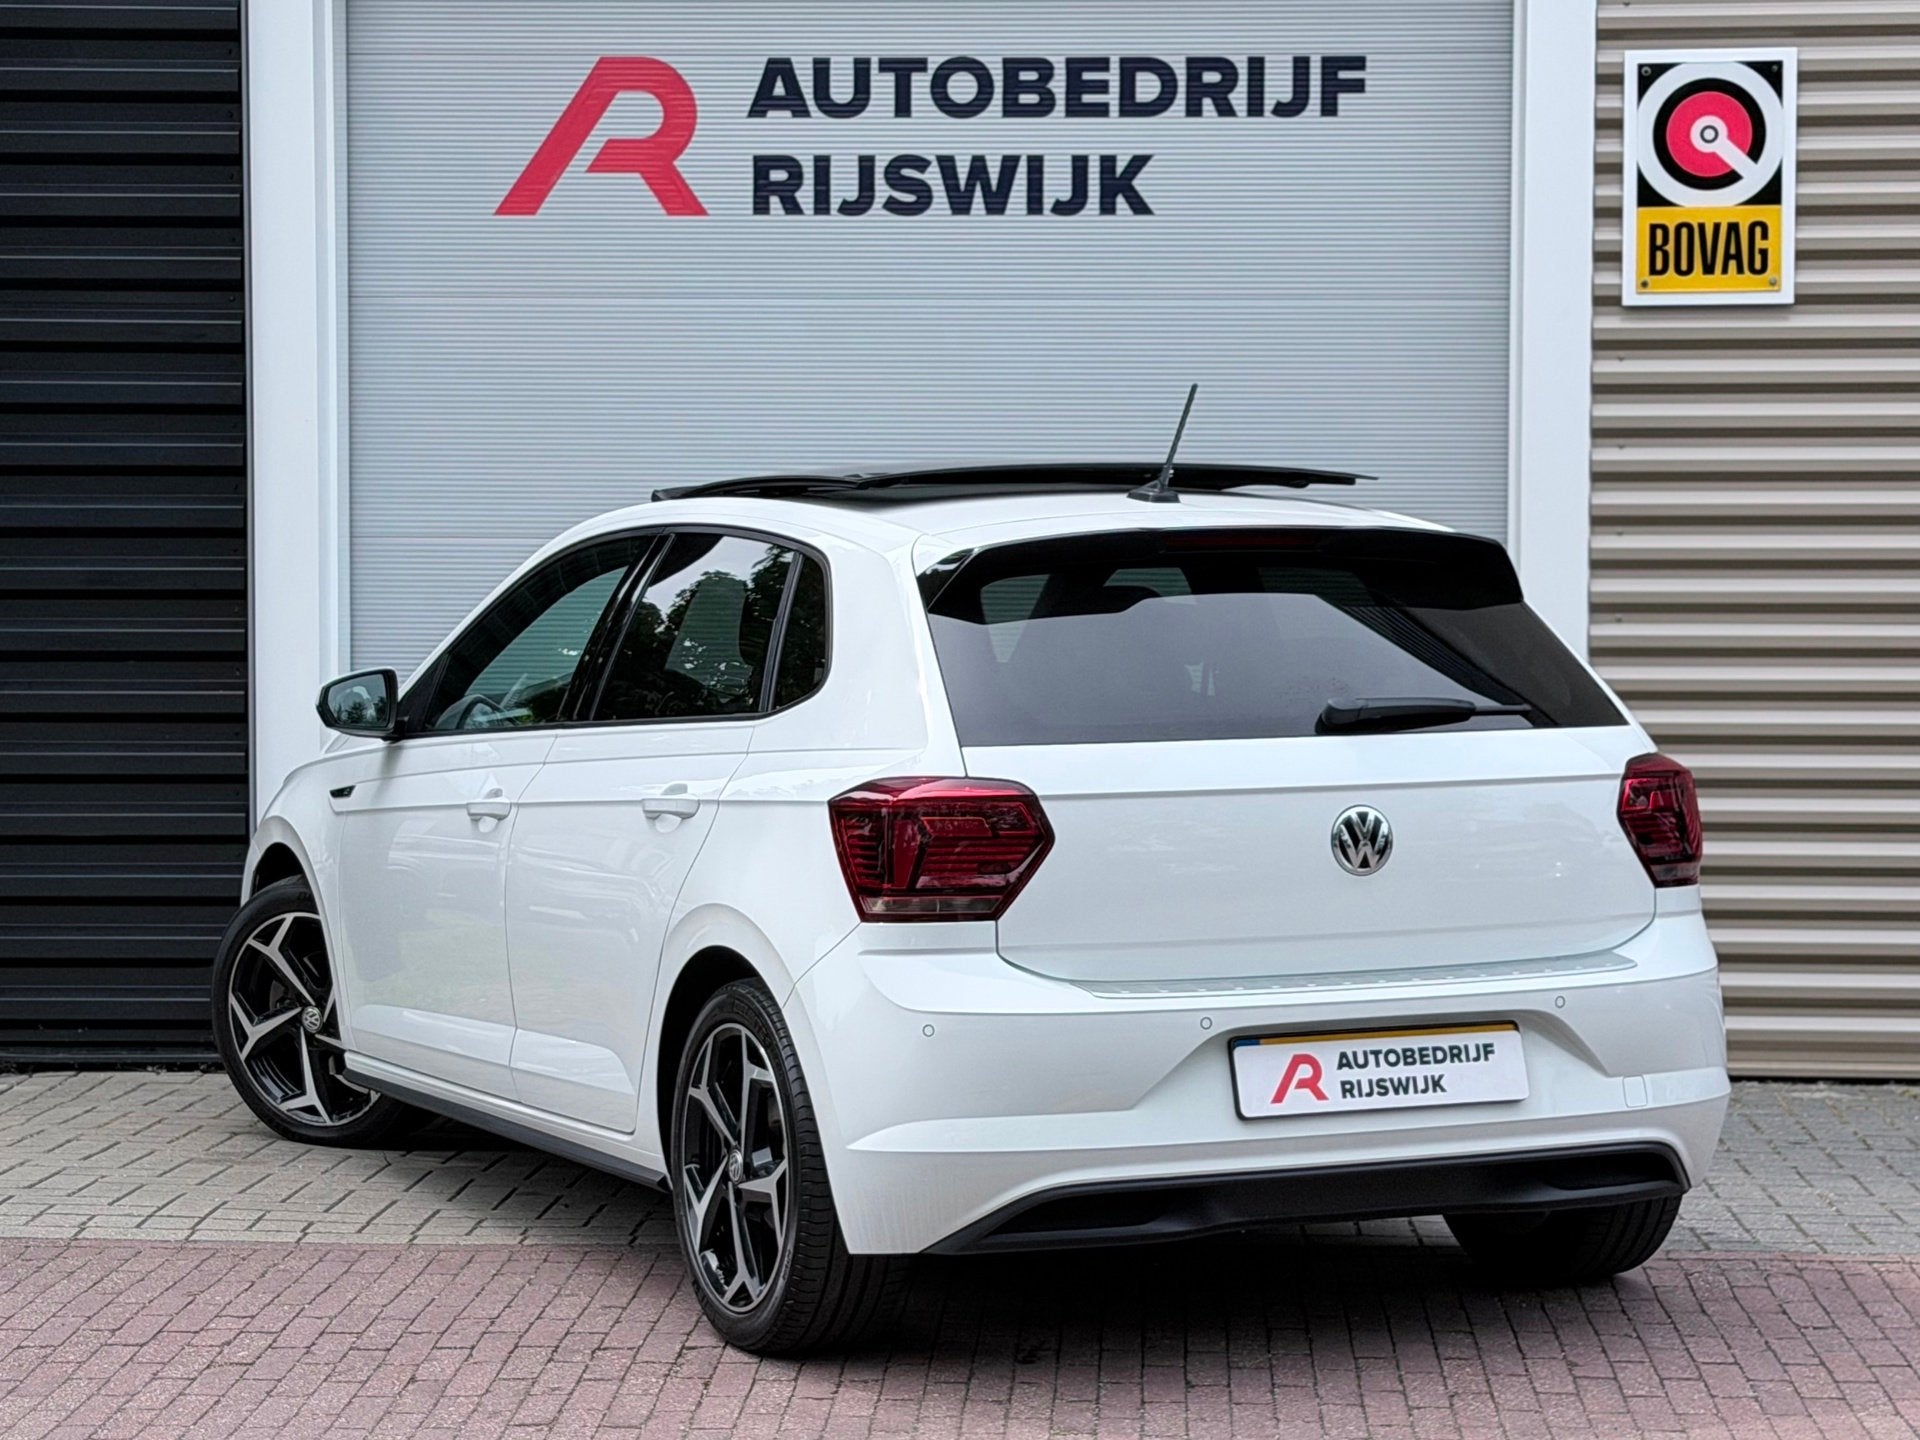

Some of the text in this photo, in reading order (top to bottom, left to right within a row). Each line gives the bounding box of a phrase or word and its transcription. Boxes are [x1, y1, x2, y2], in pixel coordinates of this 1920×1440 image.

[747, 55, 1367, 119] AUTOBEDRIJF
[752, 153, 1155, 217] RIJSWIJK
[1649, 220, 1769, 277] BOVAG
[1336, 1042, 1495, 1071] AUTOBEDRIJF
[1340, 1074, 1447, 1099] RIJSWIJK
